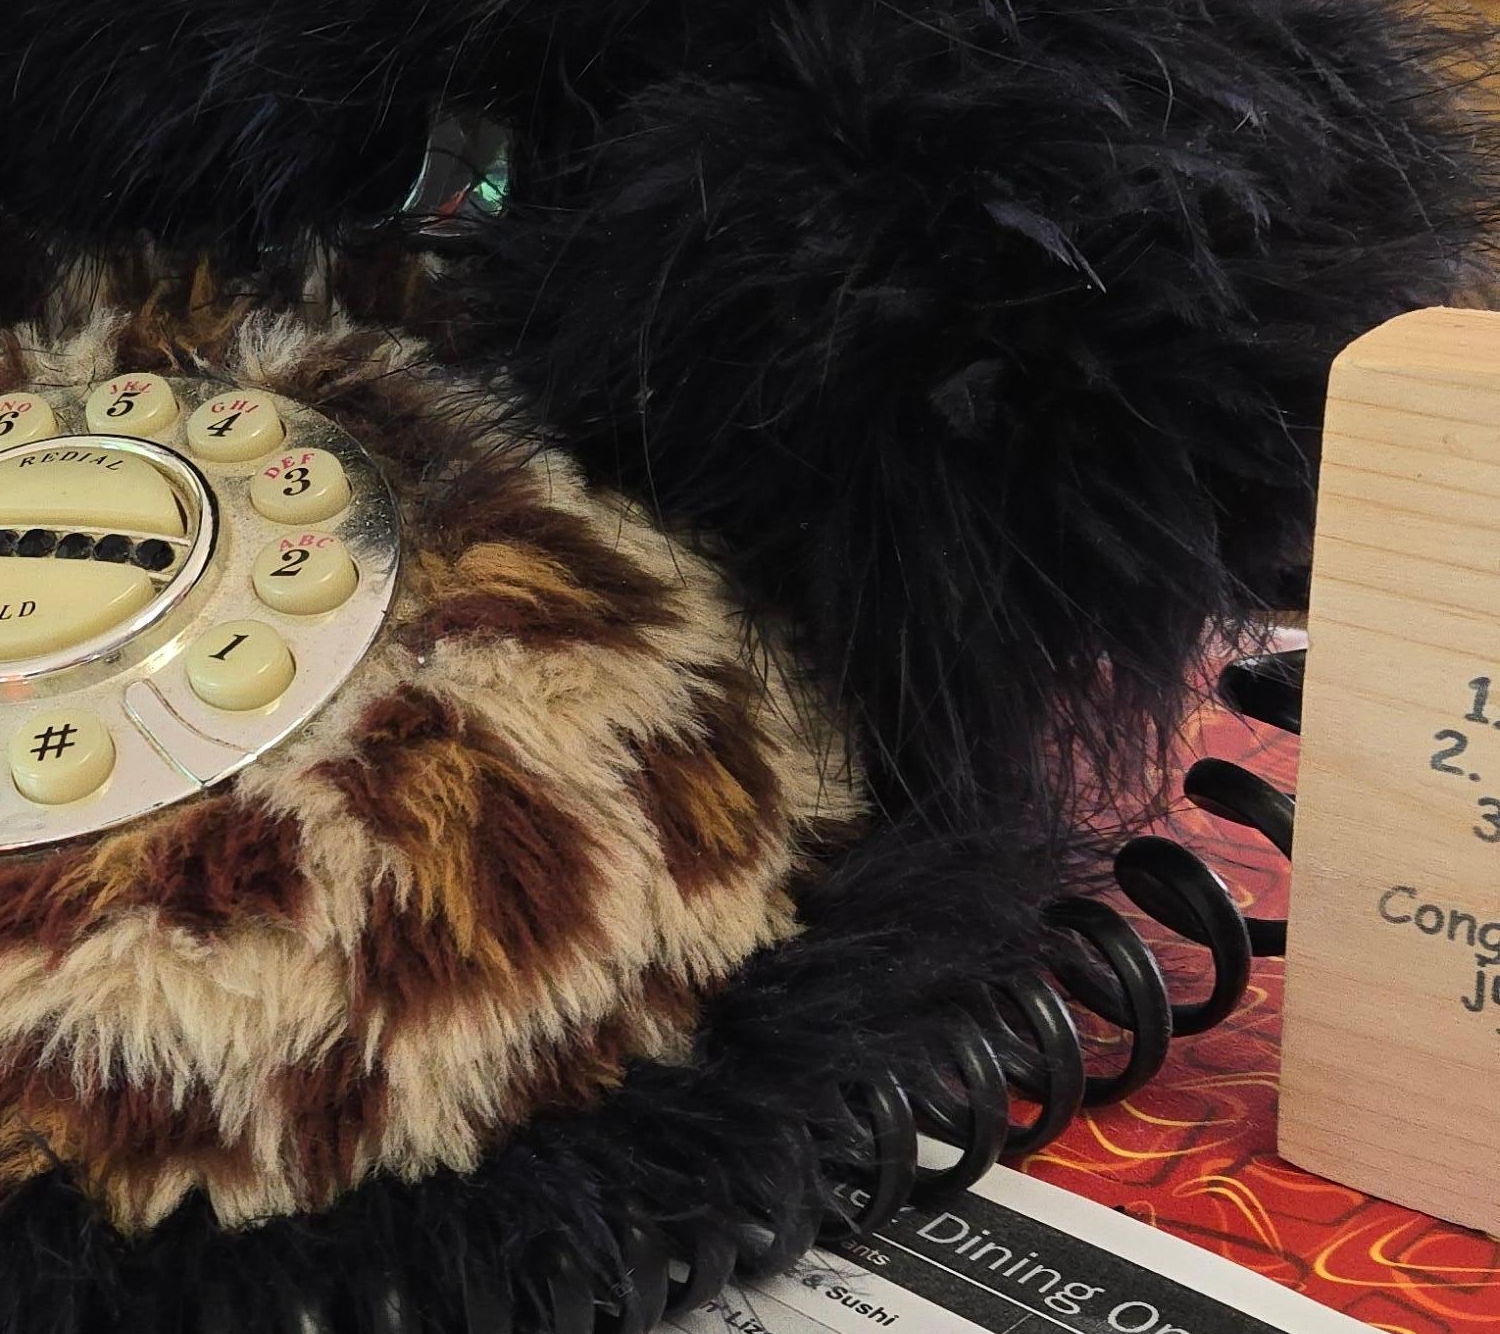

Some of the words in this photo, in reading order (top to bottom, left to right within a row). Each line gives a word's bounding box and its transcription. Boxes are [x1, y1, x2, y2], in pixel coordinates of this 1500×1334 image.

[106, 392, 141, 417] 5
[210, 399, 260, 414] GHI
[206, 412, 243, 438] 4
[19, 450, 125, 471] REDIAL
[263, 452, 315, 480] DEF
[282, 468, 311, 497] 3
[279, 534, 335, 552] ABC
[269, 548, 311, 577] 2
[208, 633, 250, 661] 1
[30, 723, 78, 762] #
[916, 1211, 1105, 1315] Dining
[827, 1285, 900, 1327] Sushi
